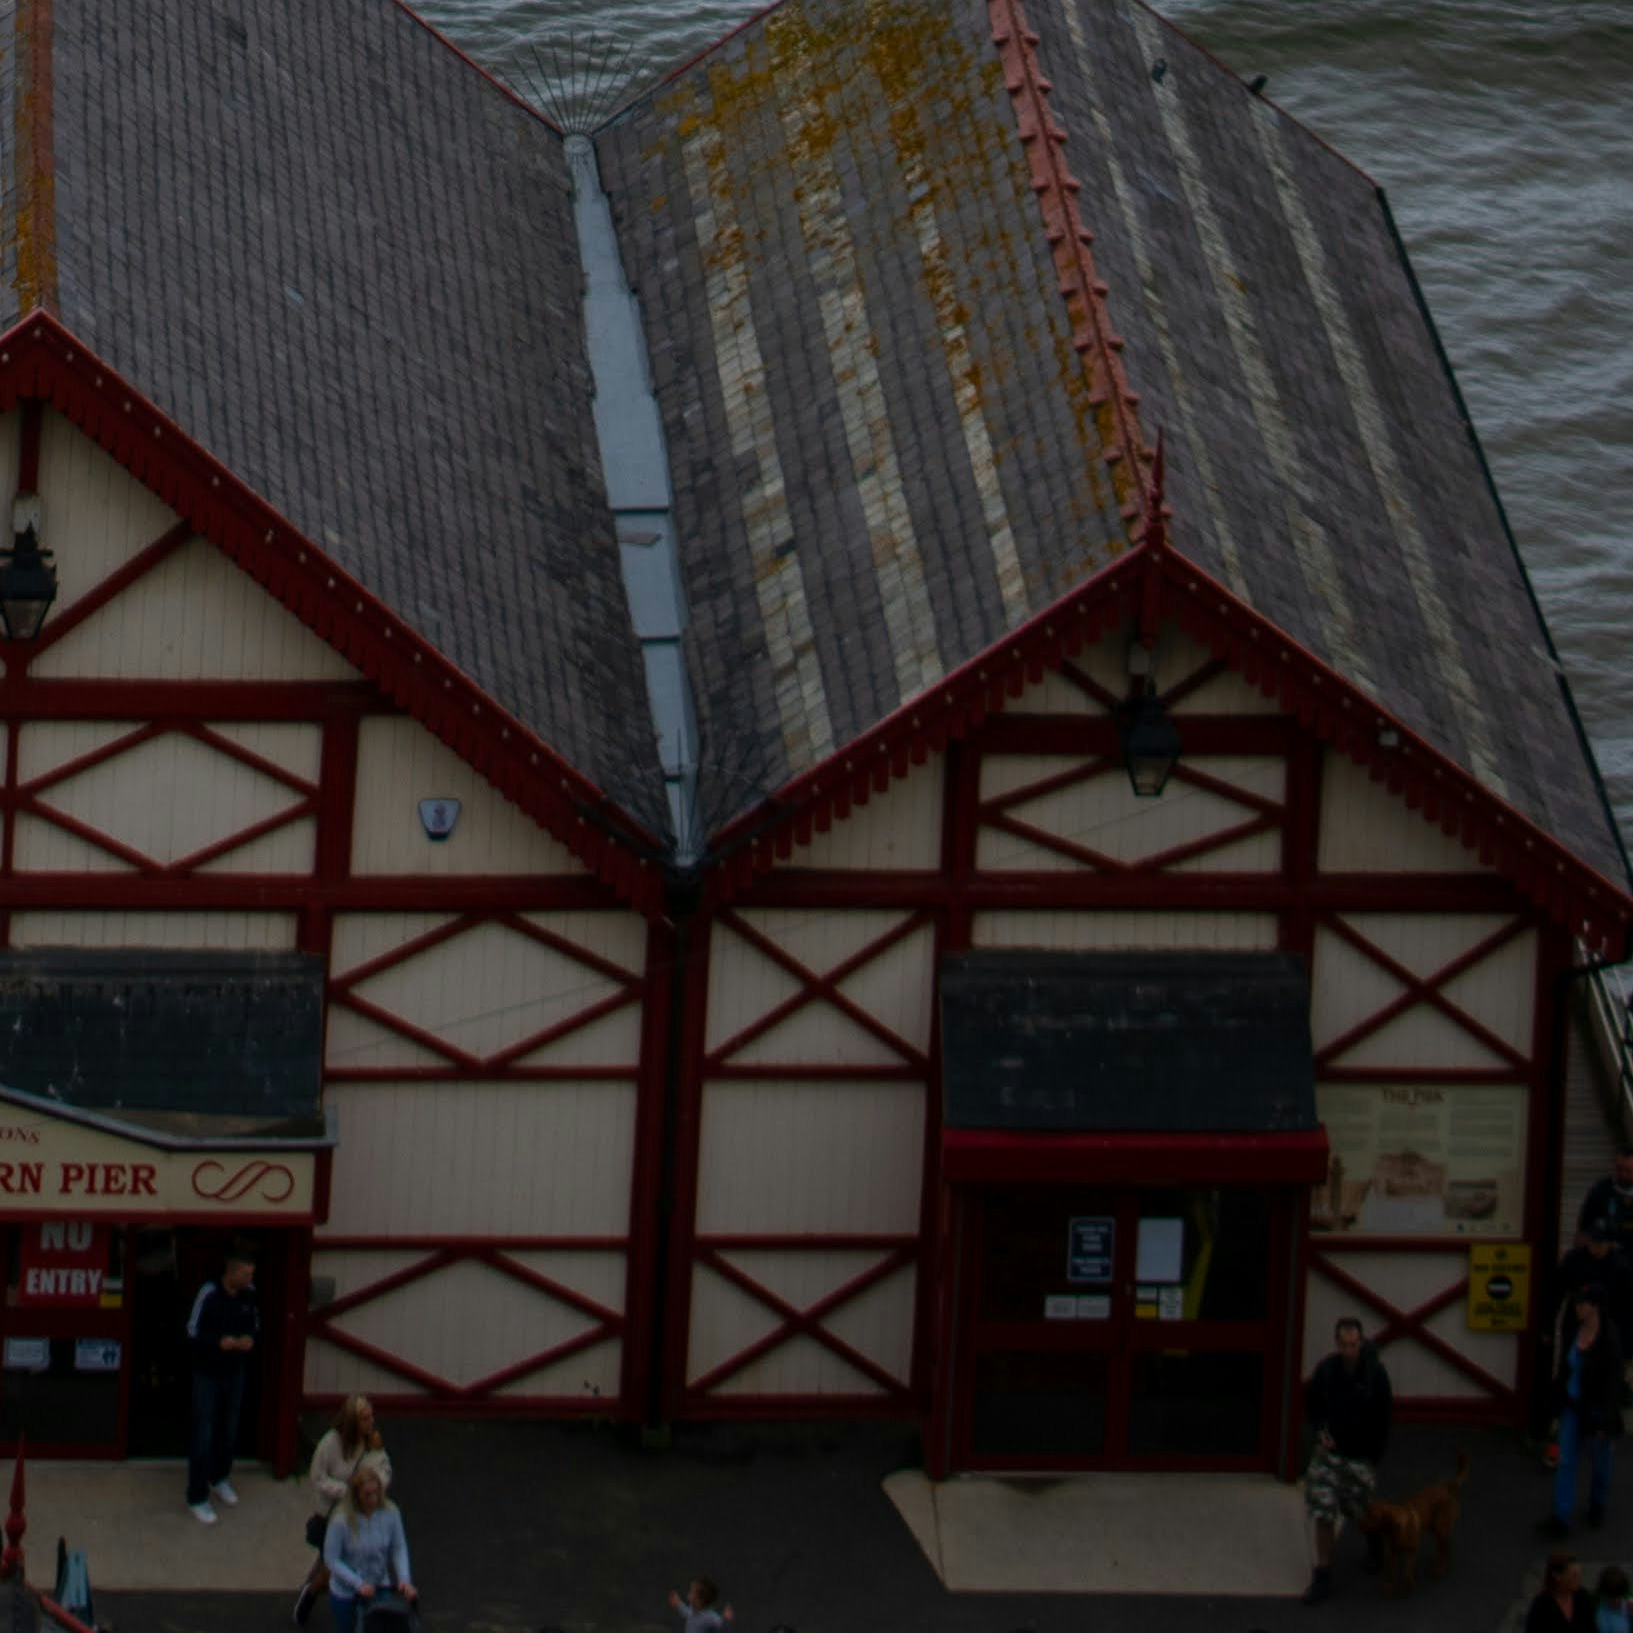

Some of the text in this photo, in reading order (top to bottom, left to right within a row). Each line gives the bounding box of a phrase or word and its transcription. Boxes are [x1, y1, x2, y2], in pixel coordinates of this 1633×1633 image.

[58, 1162, 158, 1195] PIER
[40, 1221, 94, 1251] NO
[25, 1267, 103, 1296] ENTRY
